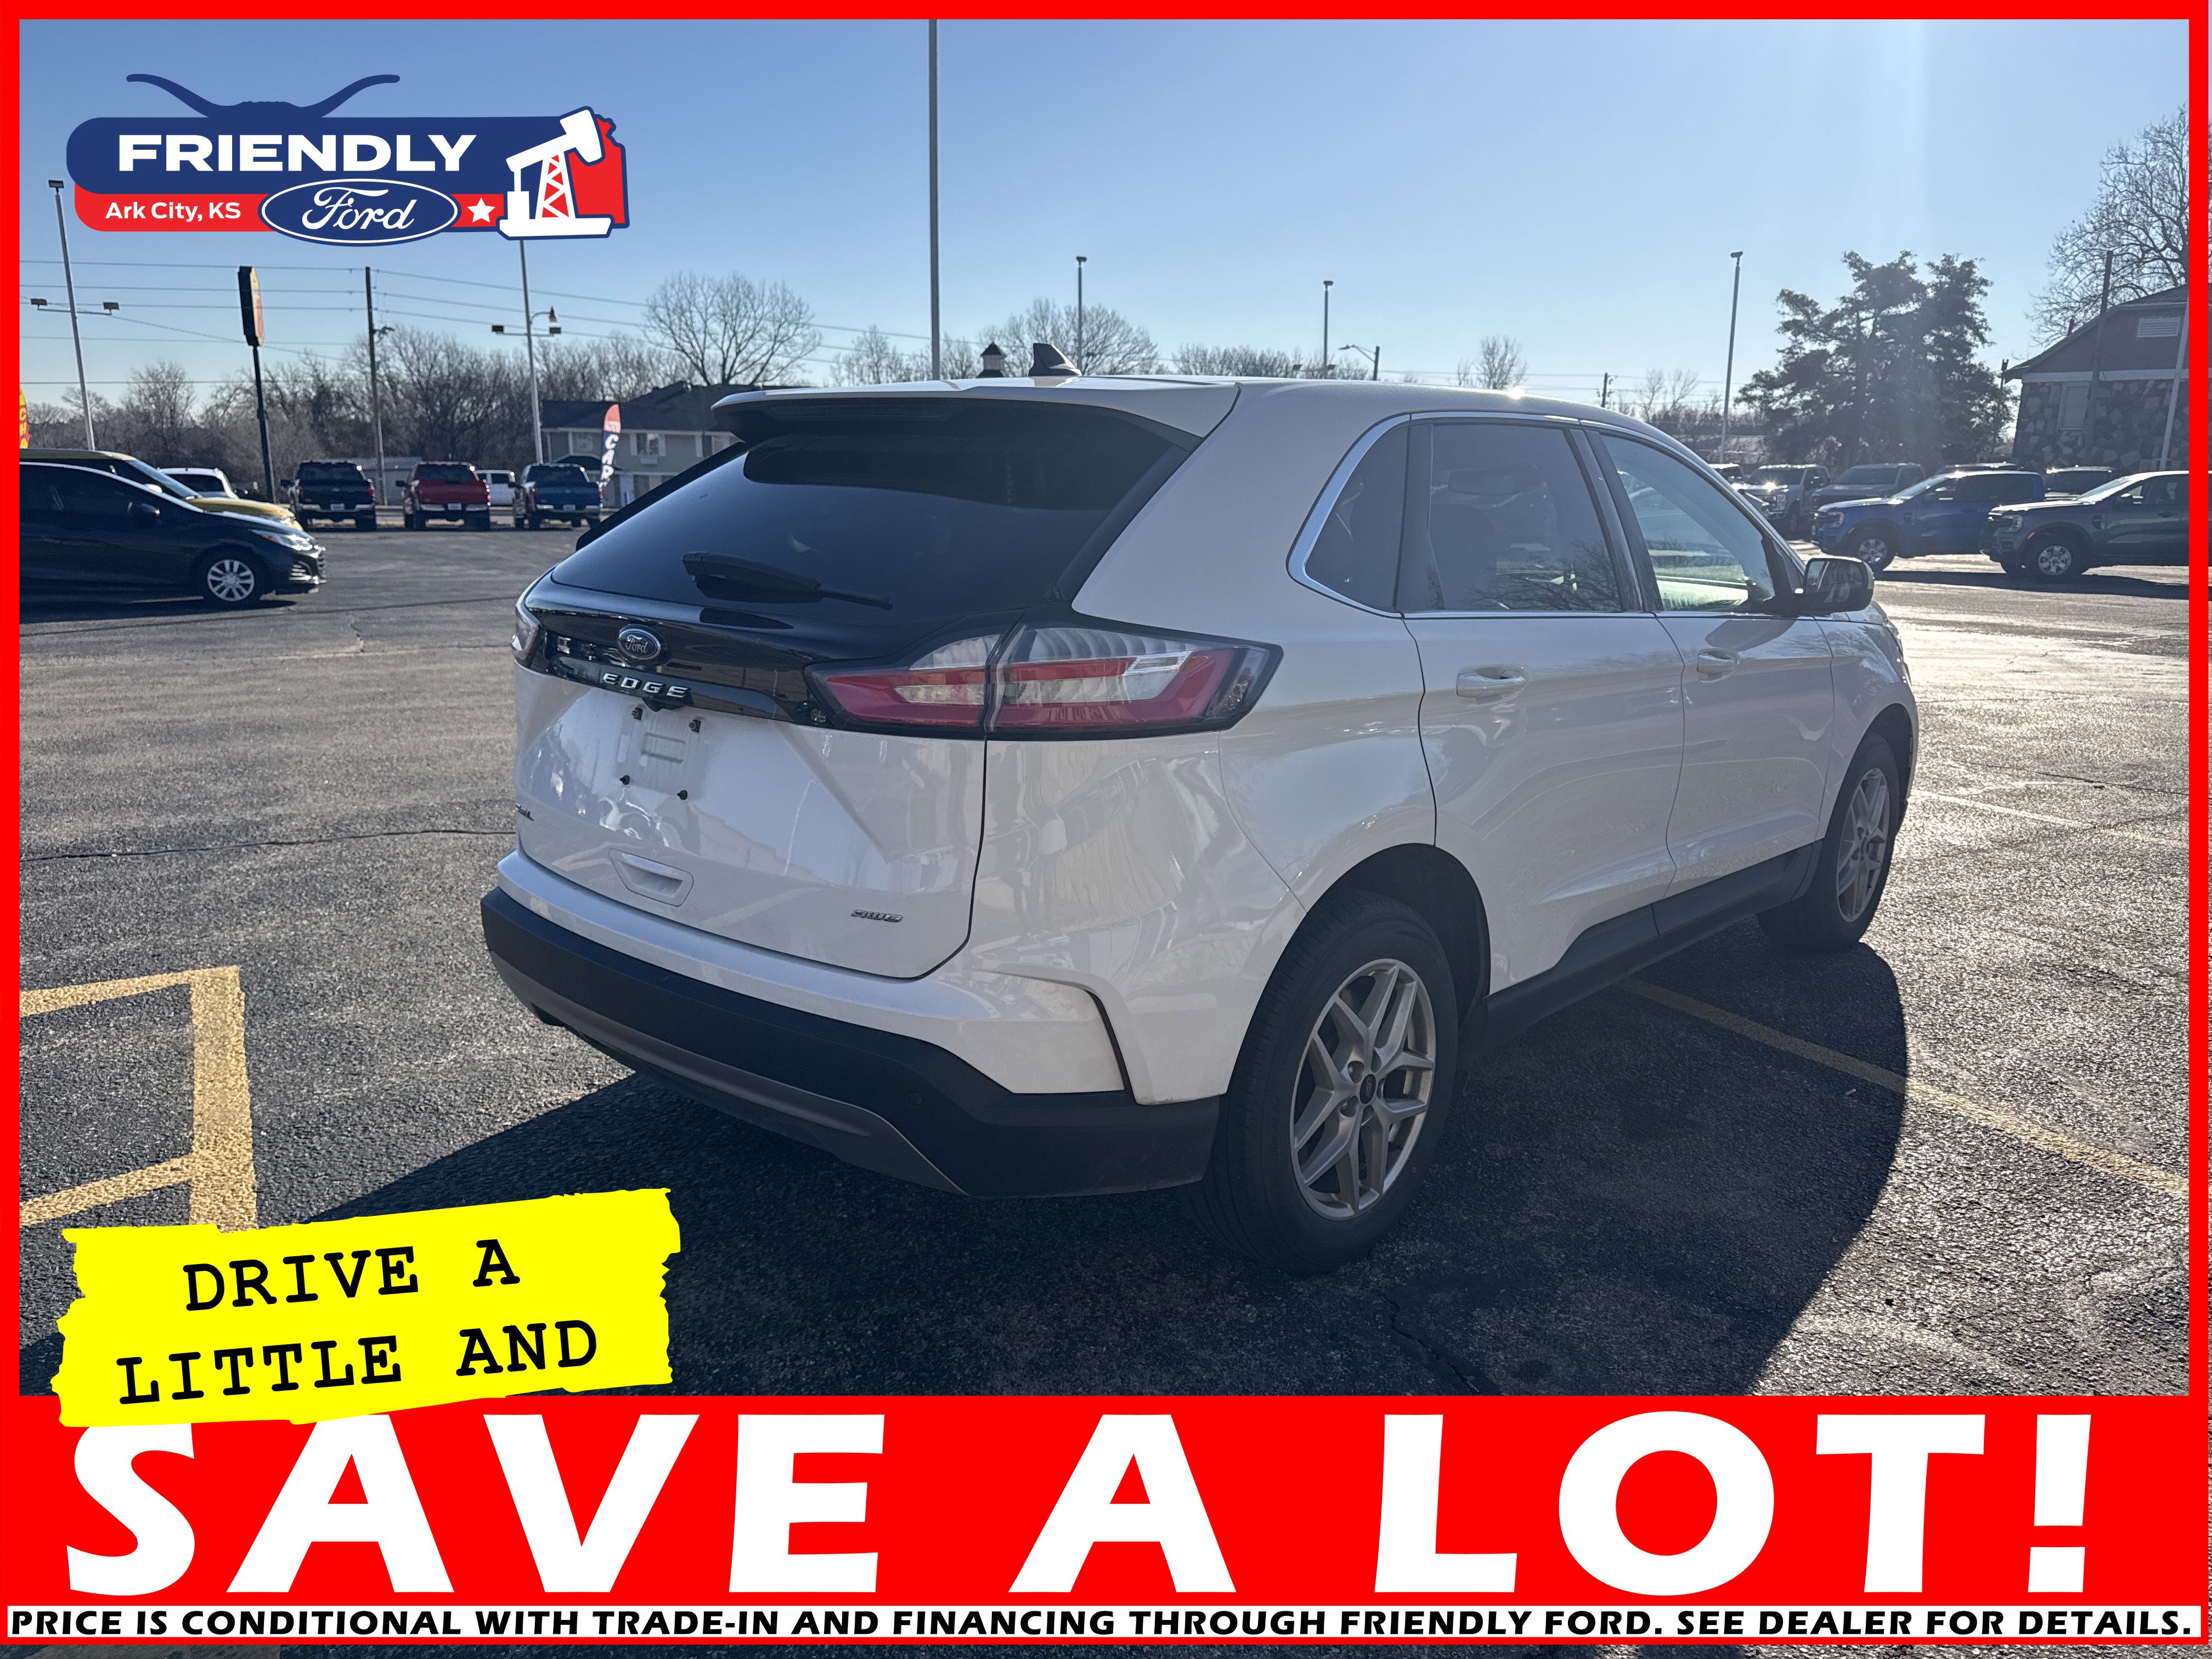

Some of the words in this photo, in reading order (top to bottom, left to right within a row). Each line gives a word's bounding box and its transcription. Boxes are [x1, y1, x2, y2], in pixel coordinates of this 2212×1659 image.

[625, 634, 648, 653] Ford
[603, 673, 691, 698] EDGE
[851, 910, 903, 922] AWD
